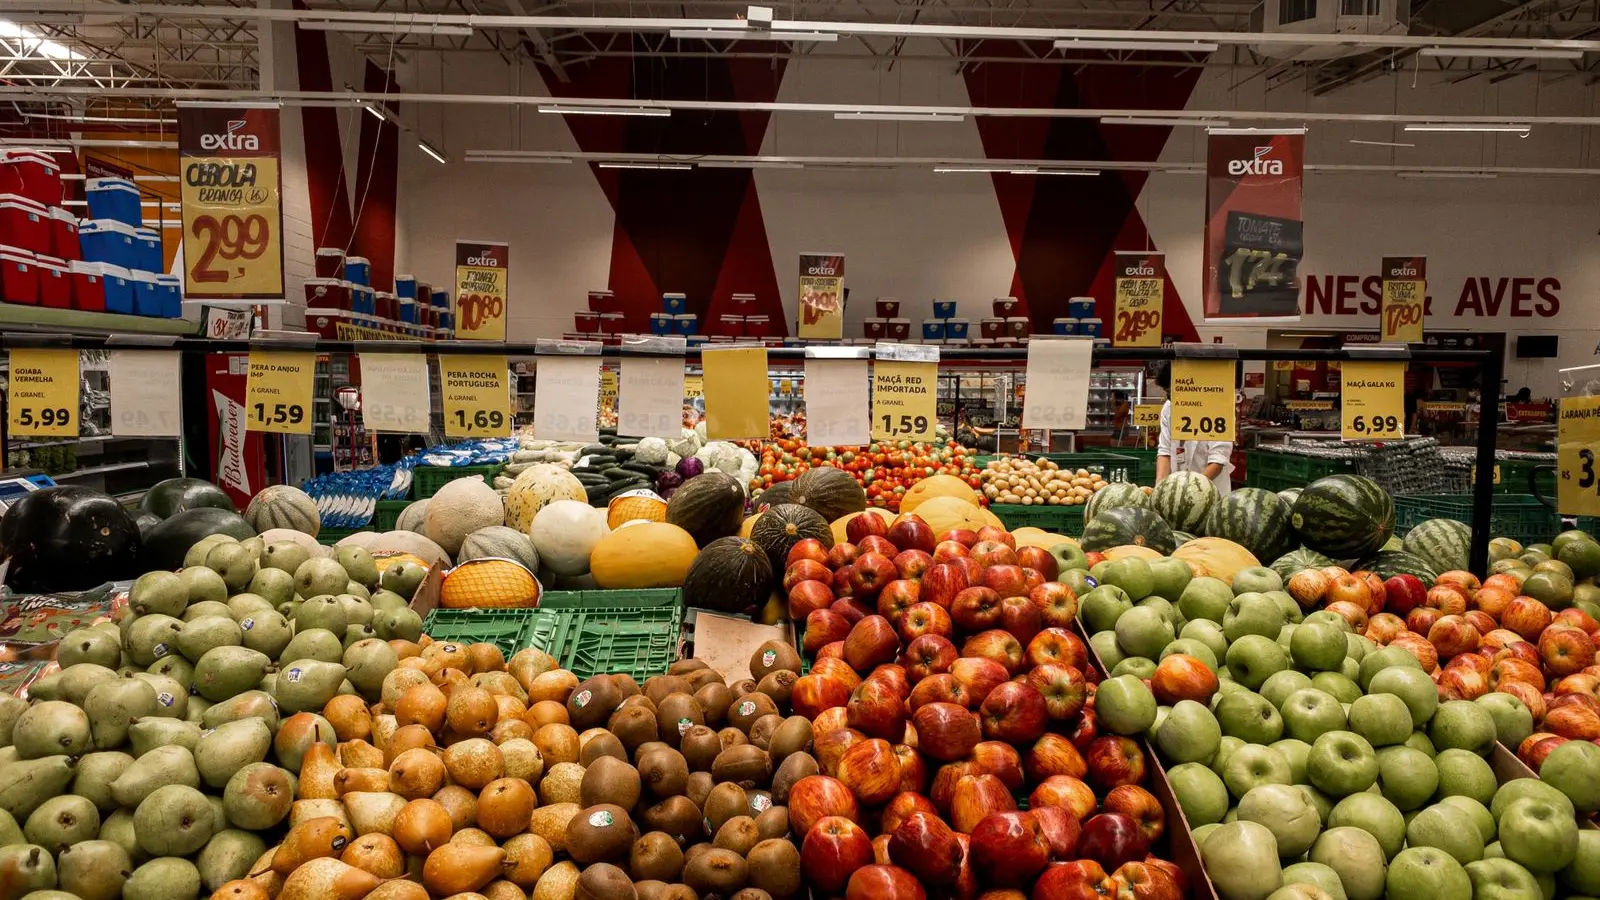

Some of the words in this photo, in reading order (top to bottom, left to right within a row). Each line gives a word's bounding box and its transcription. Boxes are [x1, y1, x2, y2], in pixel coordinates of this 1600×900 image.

[200, 130, 258, 150] extra
[1228, 158, 1283, 175] extra
[186, 162, 256, 187] CEBOLA
[198, 188, 243, 203] BRANCA
[1238, 216, 1282, 235] TOMATE
[467, 256, 497, 266] extra
[467, 270, 498, 283] FRANGO
[808, 266, 834, 275] extra
[1125, 266, 1154, 276] extra
[1391, 268, 1416, 276] extra
[1305, 275, 1383, 315] NES
[1454, 277, 1561, 318] AVES
[276, 365, 300, 373] ANJOU
[448, 380, 500, 388] PORTUGUESA
[878, 374, 900, 386] MAÇÃ
[1175, 378, 1194, 386] MAÇÃ
[1346, 380, 1366, 388] MAÇÃ
[877, 385, 927, 394] IMPORTADA
[20, 408, 70, 429] 5,99
[254, 403, 304, 426] 1,59
[454, 410, 504, 431] 1,69
[1140, 414, 1159, 422] 2,59
[1562, 410, 1590, 420] LARANJA
[881, 414, 928, 436] 1,59
[1181, 416, 1226, 436] 2,08
[1352, 415, 1398, 435] 6,99
[224, 400, 242, 488] Budweiser
[1562, 471, 1571, 480] R$
